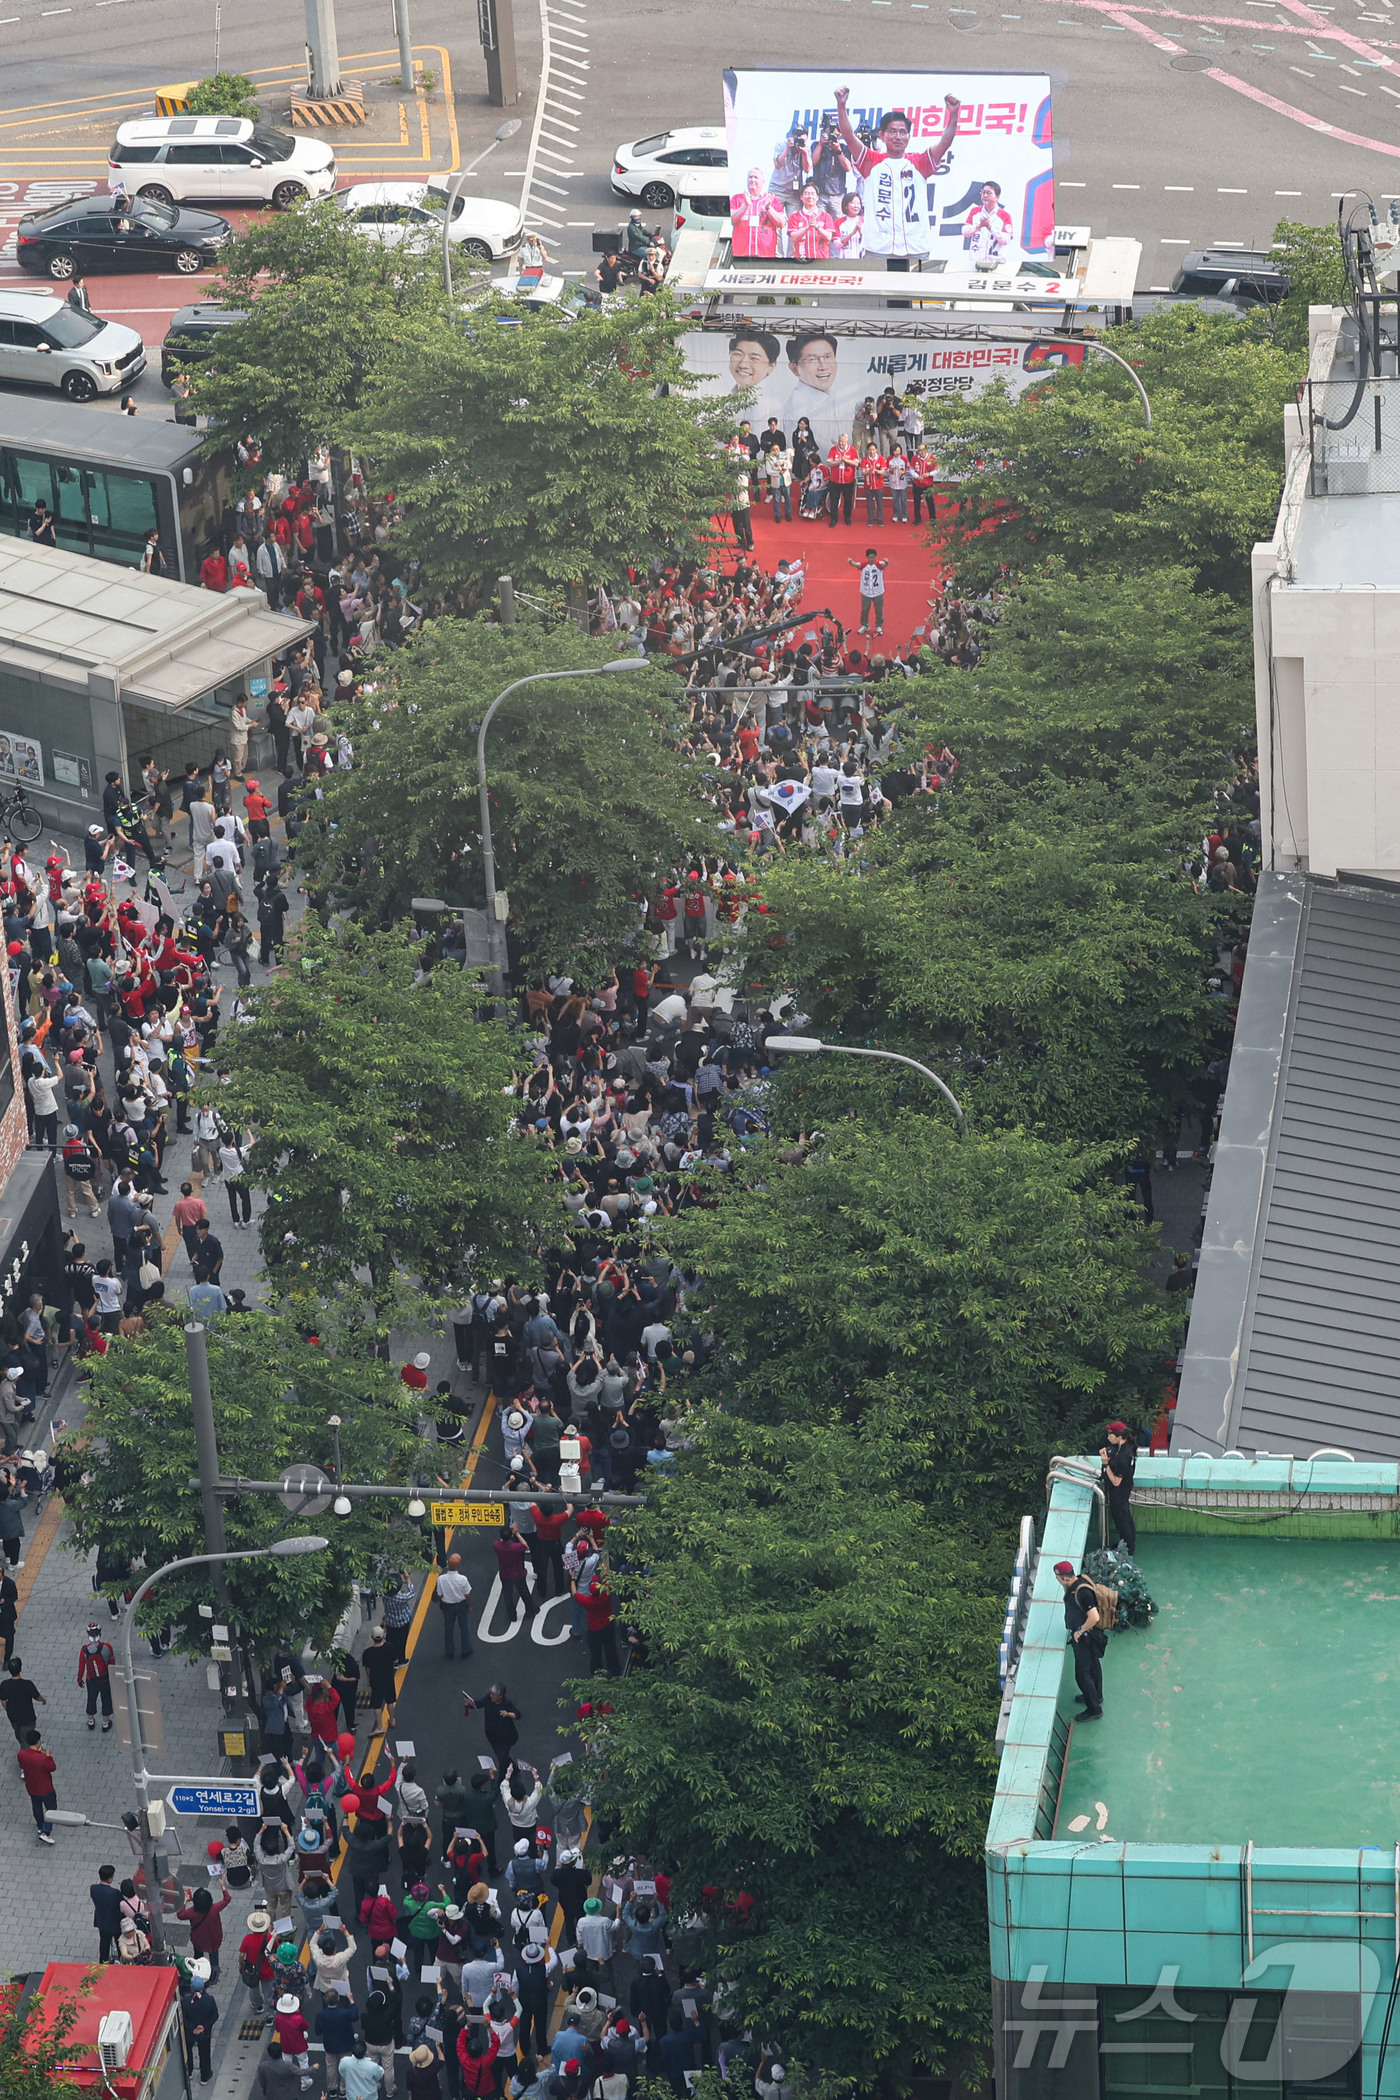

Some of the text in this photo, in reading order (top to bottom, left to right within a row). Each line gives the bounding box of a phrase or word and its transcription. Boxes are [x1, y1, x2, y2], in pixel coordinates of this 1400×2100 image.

[718, 274, 864, 286] 새롭게 대한민국!
[1045, 282, 1061, 294] 2
[867, 348, 1019, 374] 새롭게 대한민국!
[471, 1508, 482, 1522] 무인
[484, 1508, 501, 1522] 단속중
[196, 1790, 255, 1806] 연세로2길
[199, 1804, 256, 1814] Yonsei-ro 2-gil
